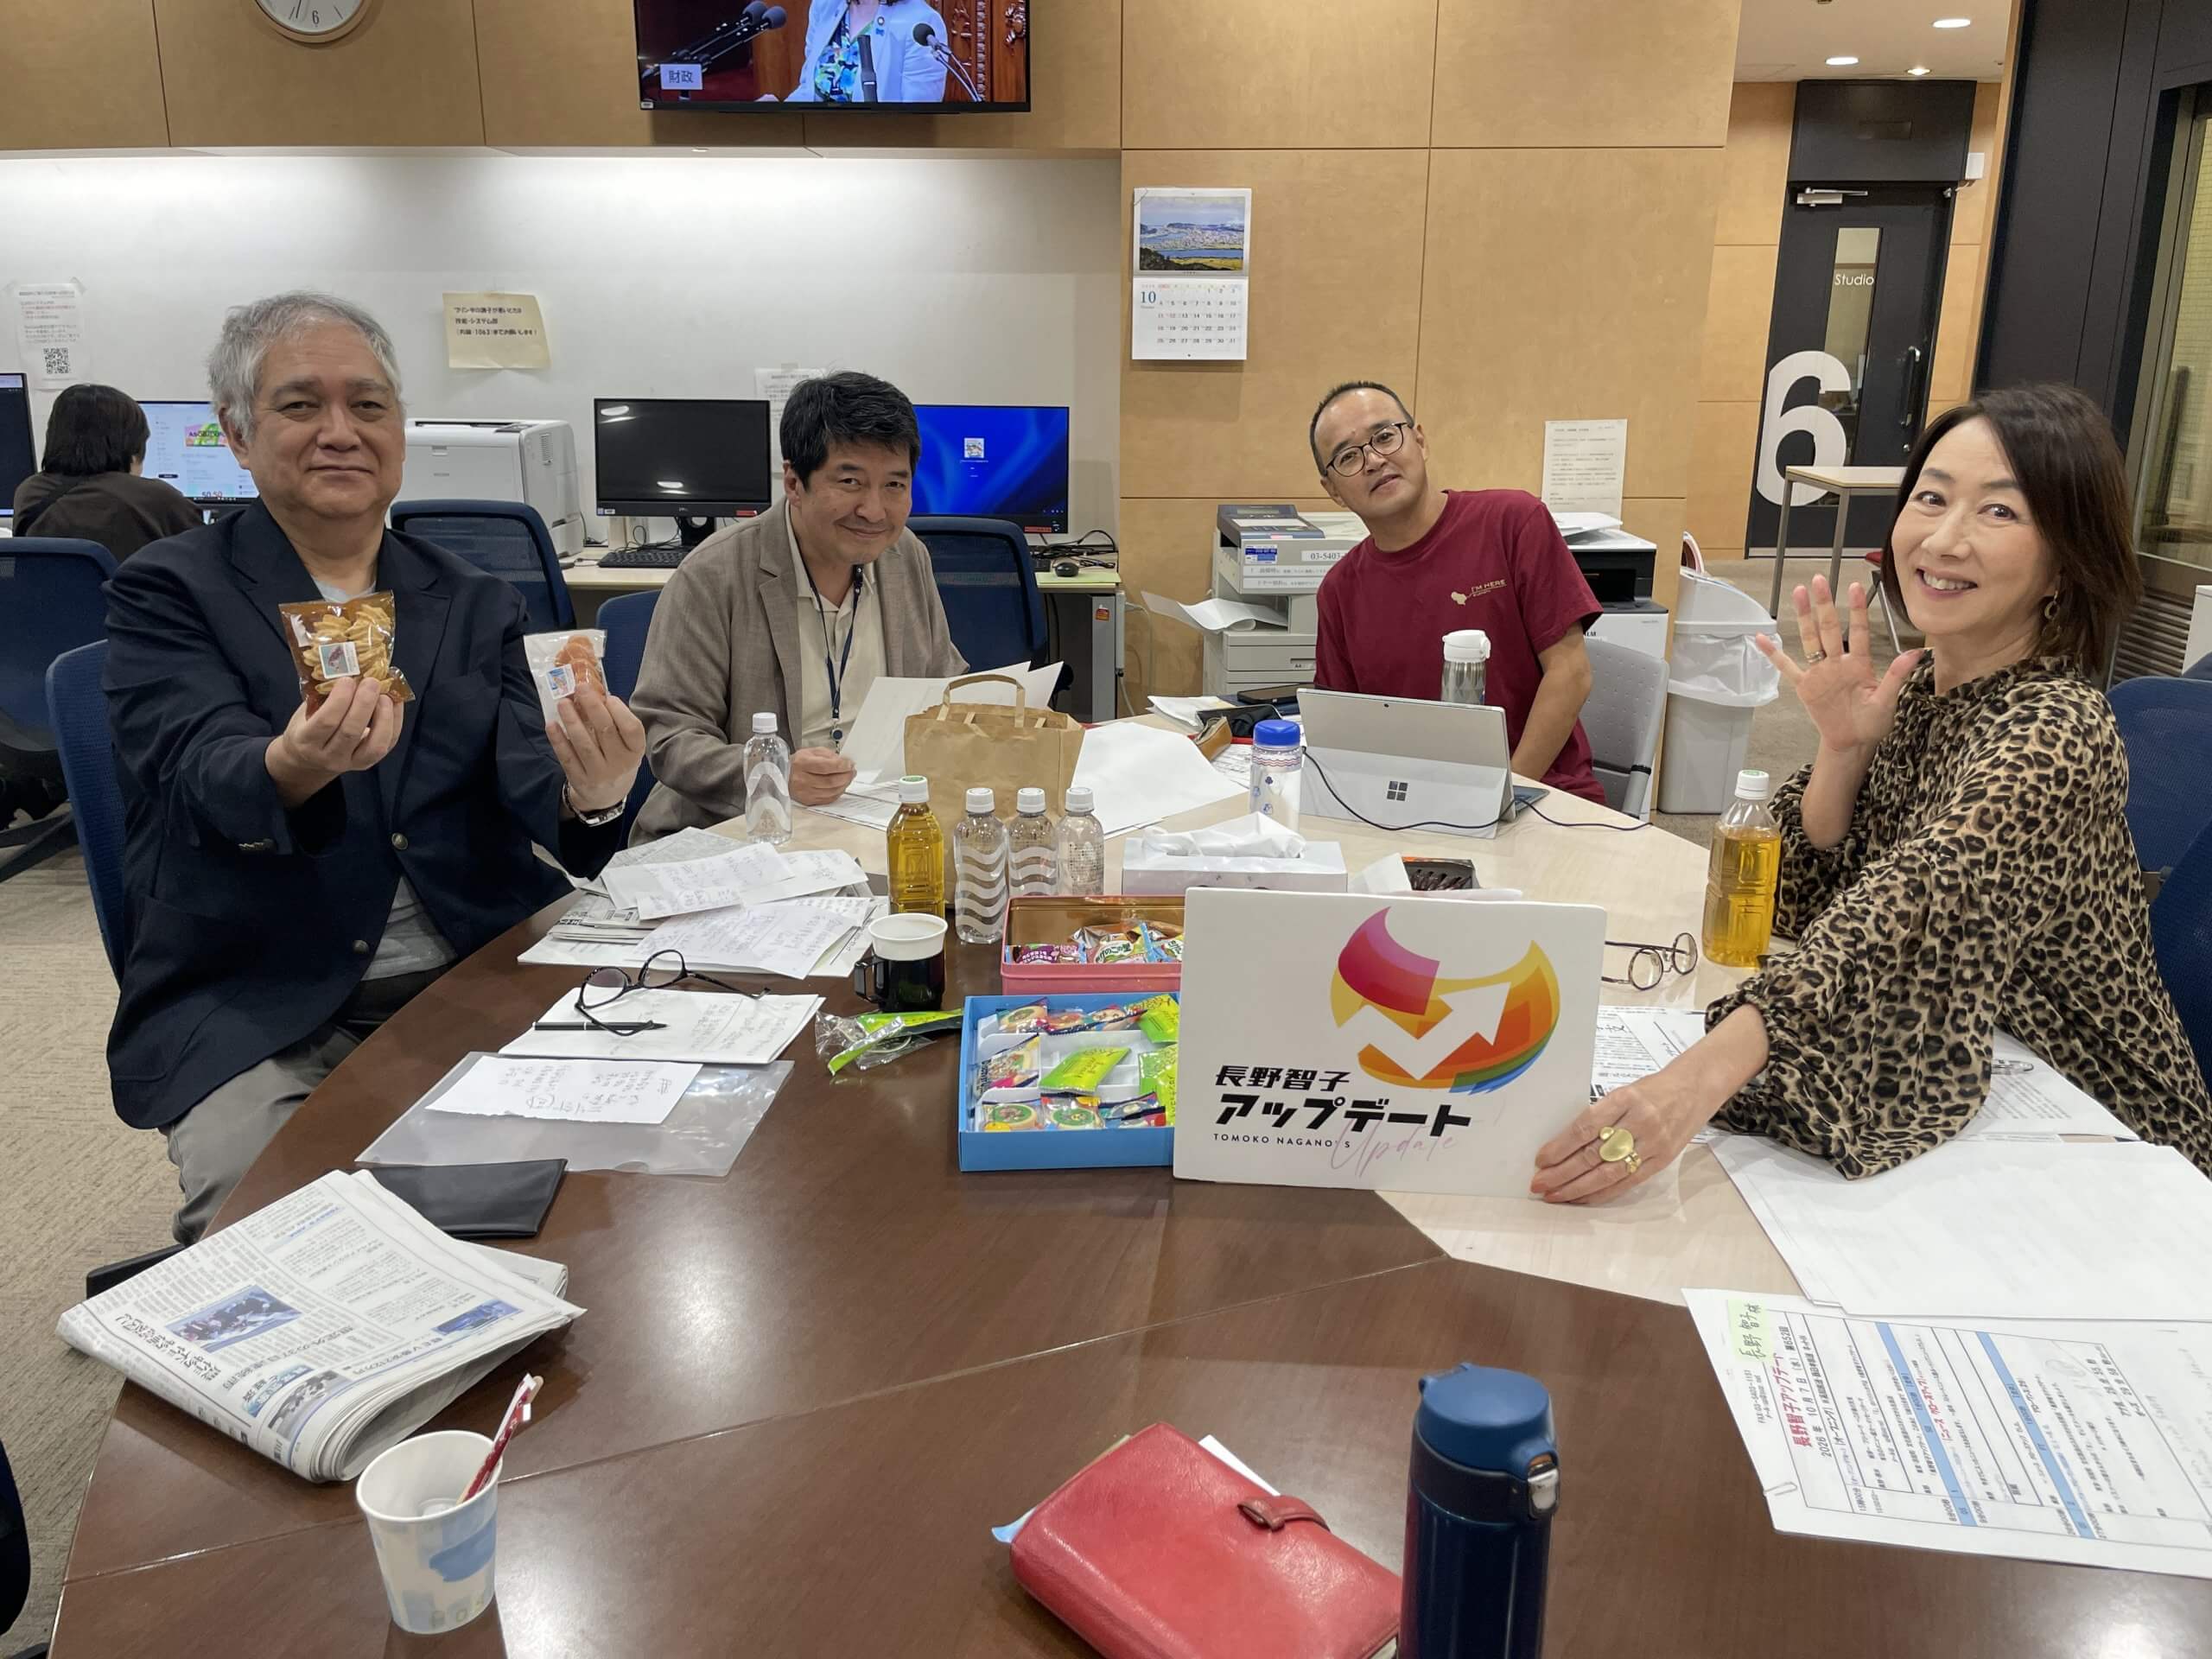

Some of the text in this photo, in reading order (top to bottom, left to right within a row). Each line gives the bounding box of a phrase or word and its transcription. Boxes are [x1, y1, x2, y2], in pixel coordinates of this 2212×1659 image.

[312, 10, 320, 25] 6
[669, 70, 693, 83] 財政
[1834, 273, 1875, 286] Studio
[1141, 290, 1156, 303] 10
[1757, 351, 1852, 507] 6
[1215, 1065, 1351, 1092] 長野智子
[1216, 1093, 1471, 1137] アップデート
[1214, 1133, 1269, 1144] TOMOKO
[1331, 1116, 1460, 1179] Update
[1738, 1334, 1766, 1359] 長野
[1772, 1353, 1812, 1446] 長野智子アップデート
